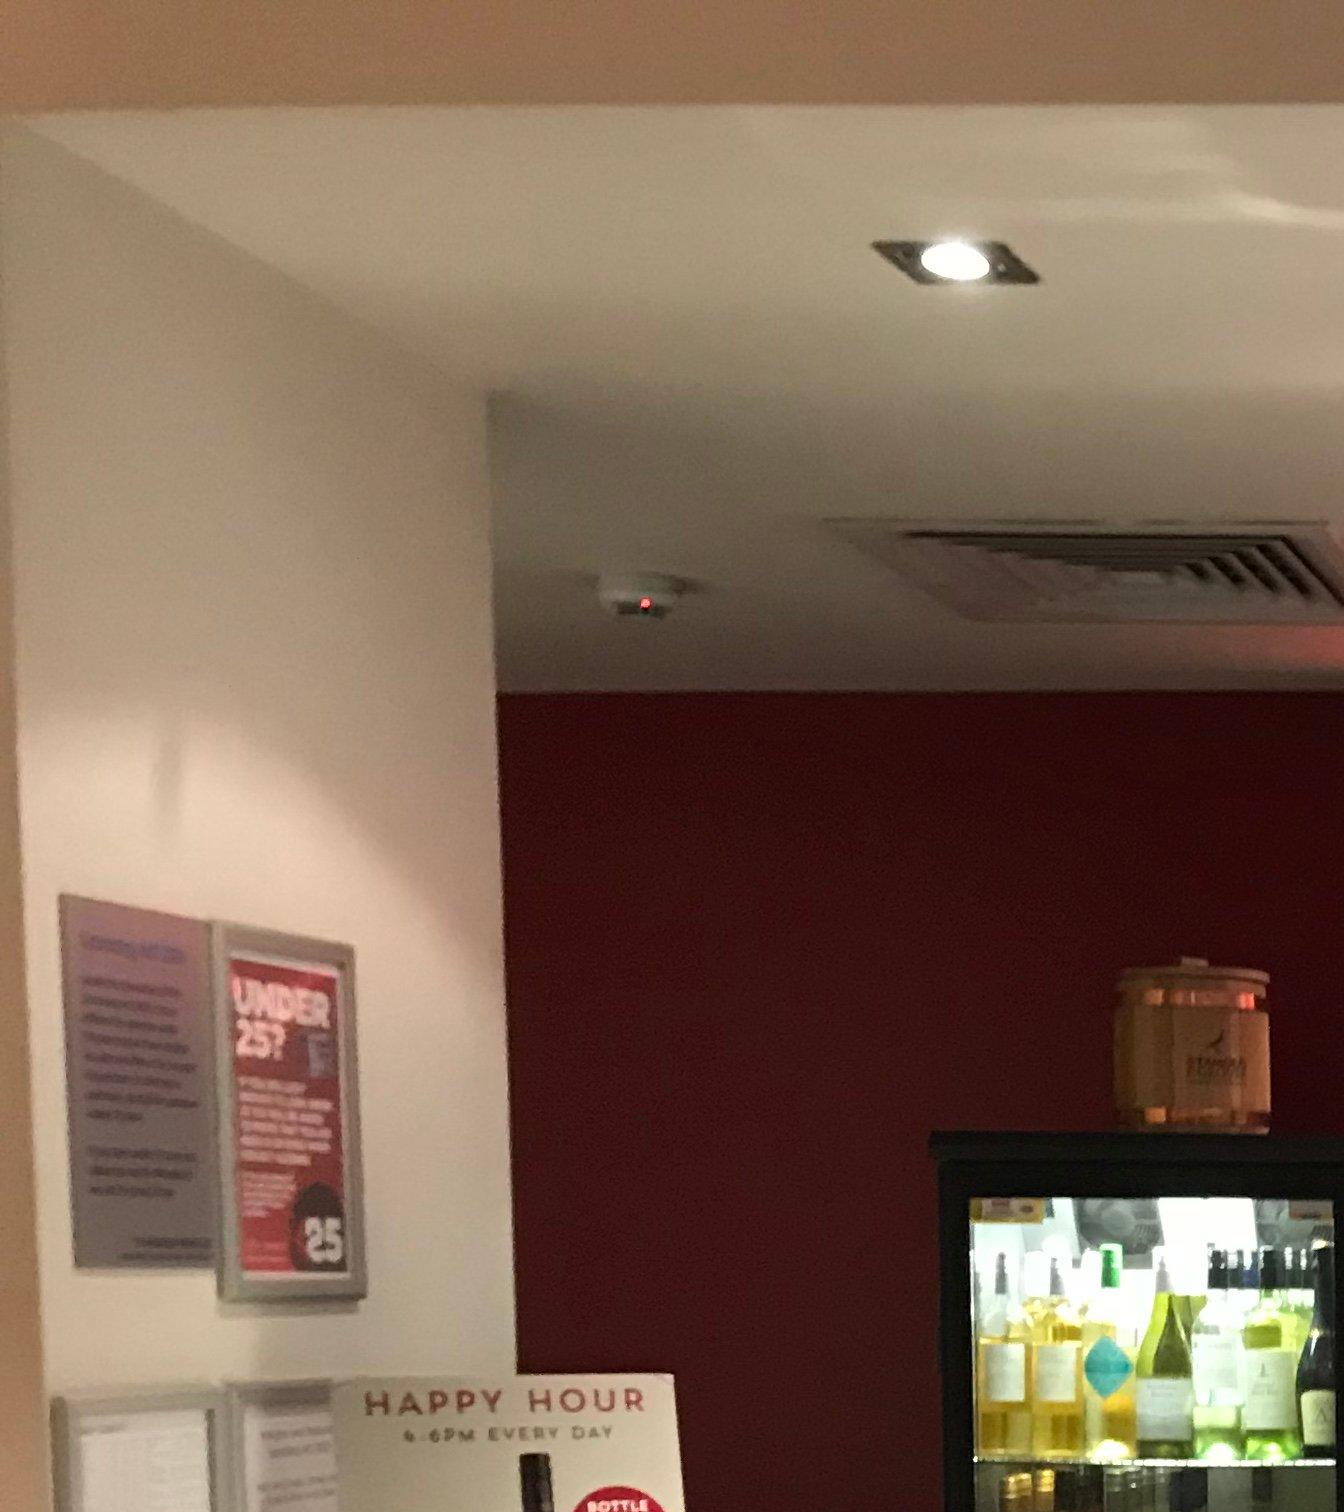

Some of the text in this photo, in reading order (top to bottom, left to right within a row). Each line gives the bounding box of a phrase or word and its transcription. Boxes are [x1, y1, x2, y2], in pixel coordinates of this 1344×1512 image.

[232, 975, 330, 1029] UNDER
[304, 1216, 344, 1264] 25
[364, 1386, 645, 1416] HAPPY HOUR
[488, 1425, 558, 1442] EVERY
[572, 1424, 613, 1440] DAY
